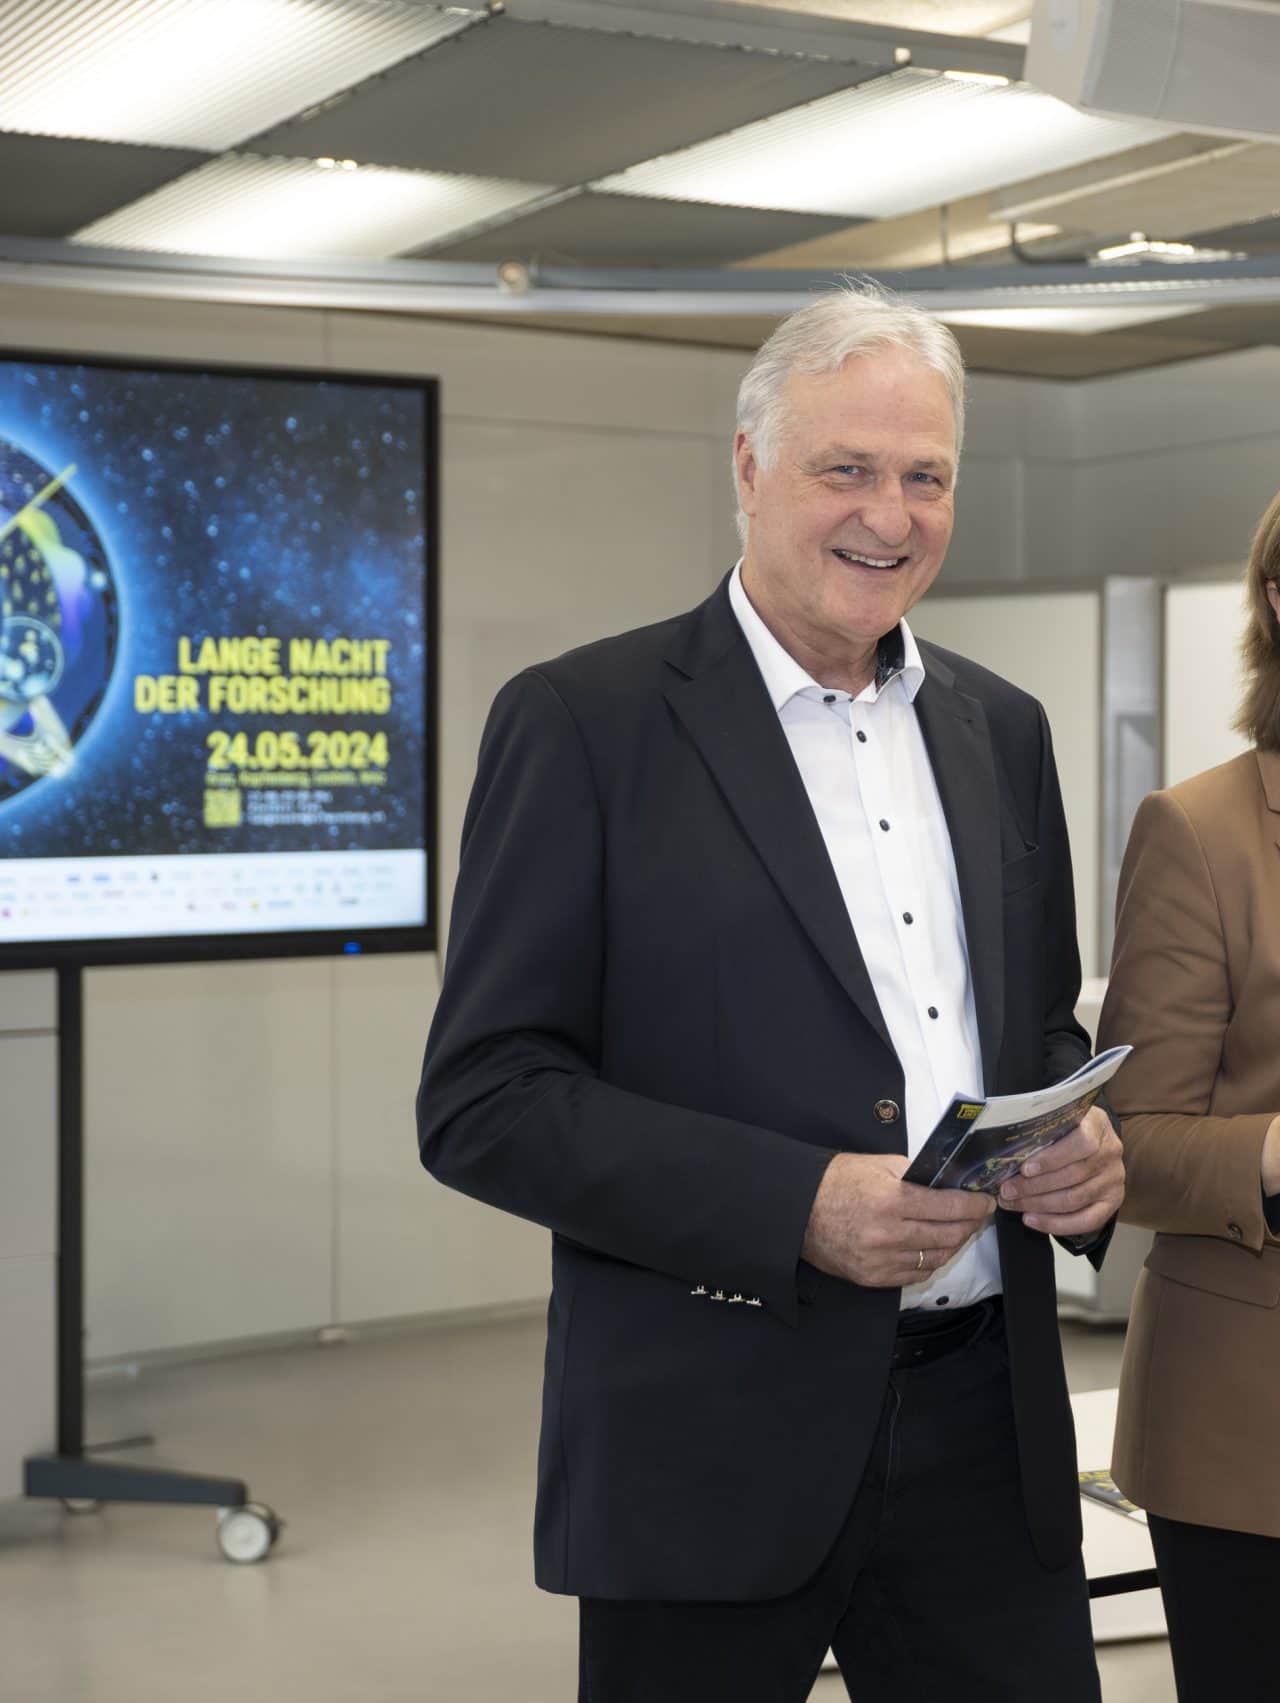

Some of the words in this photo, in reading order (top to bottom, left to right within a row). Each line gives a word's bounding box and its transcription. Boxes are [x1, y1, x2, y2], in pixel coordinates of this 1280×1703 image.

[178, 636, 281, 674] LANGE
[289, 638, 391, 675] NACHT
[134, 674, 199, 714] DER
[208, 675, 391, 714] FORSCHUNG
[207, 730, 389, 769] 24.05.2024
